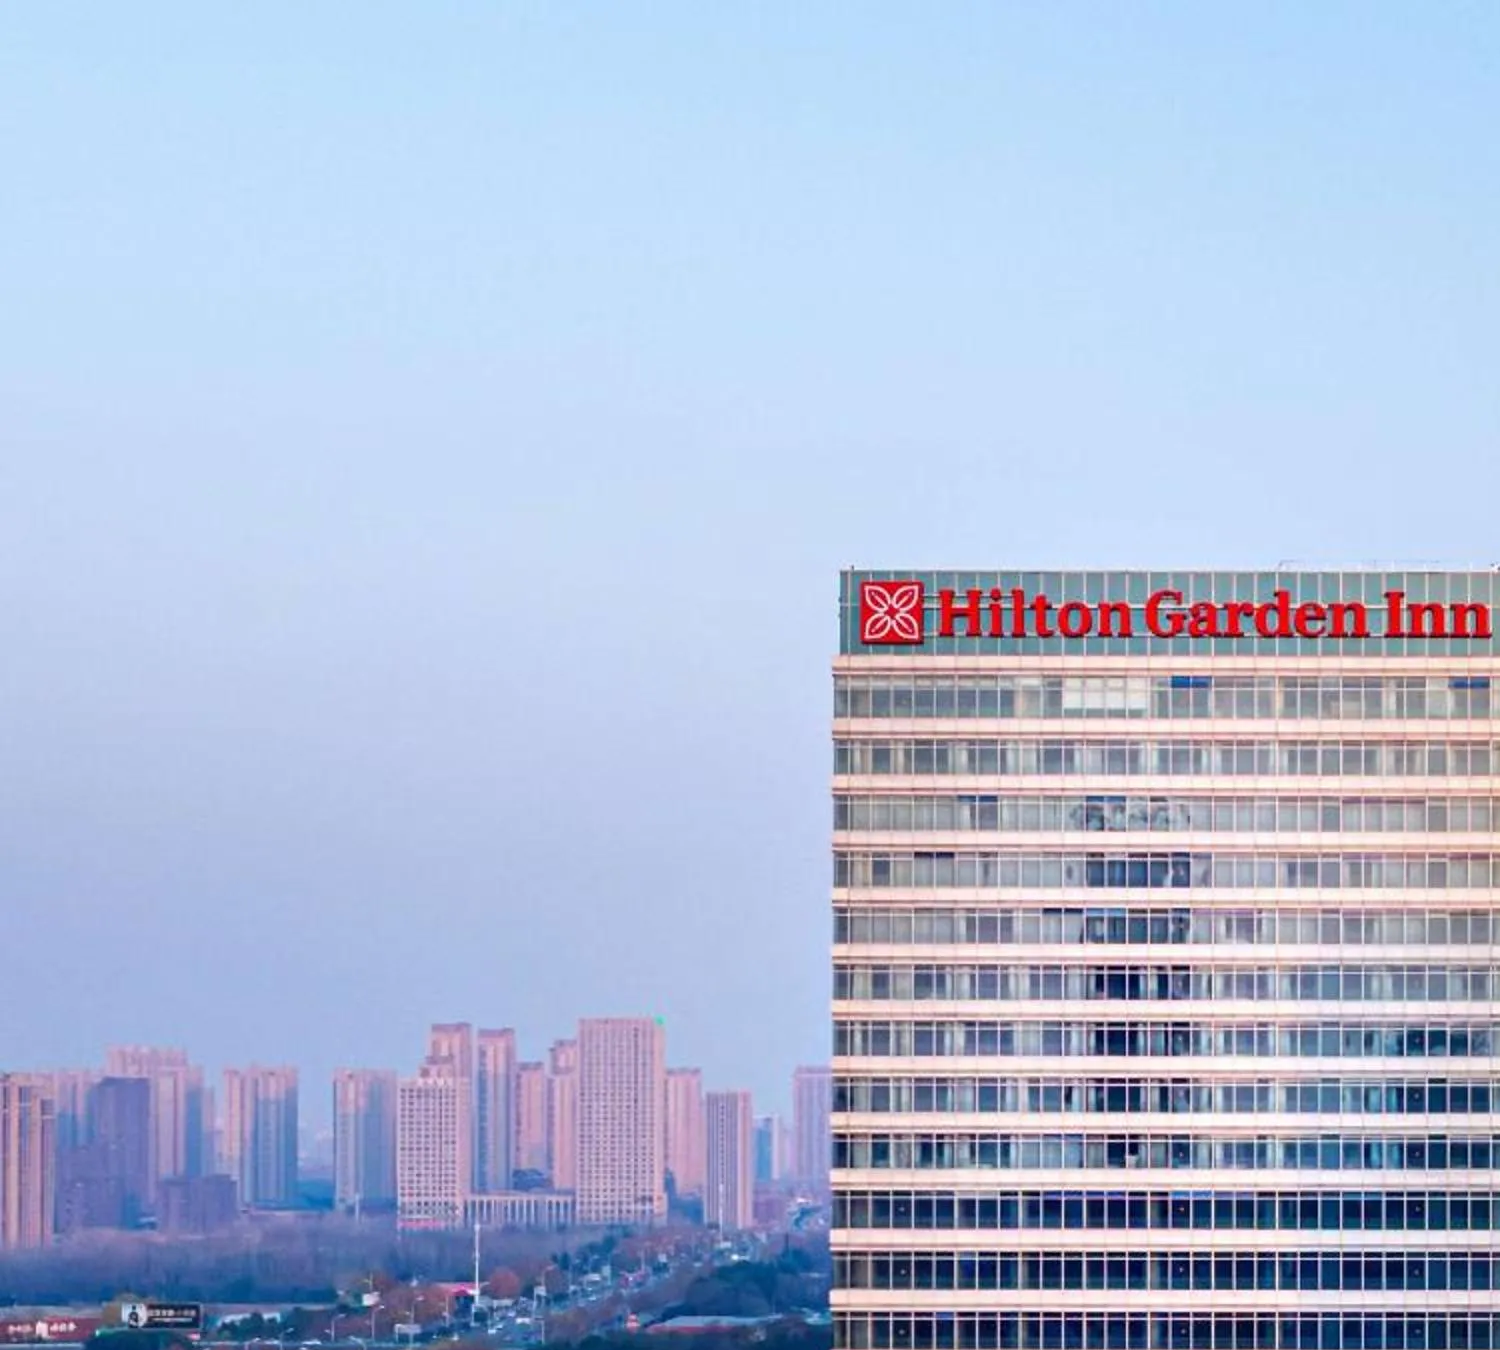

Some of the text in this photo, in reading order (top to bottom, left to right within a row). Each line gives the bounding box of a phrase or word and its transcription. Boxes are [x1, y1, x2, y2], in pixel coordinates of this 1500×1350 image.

[938, 588, 1491, 639] Hilton Garden Inn
